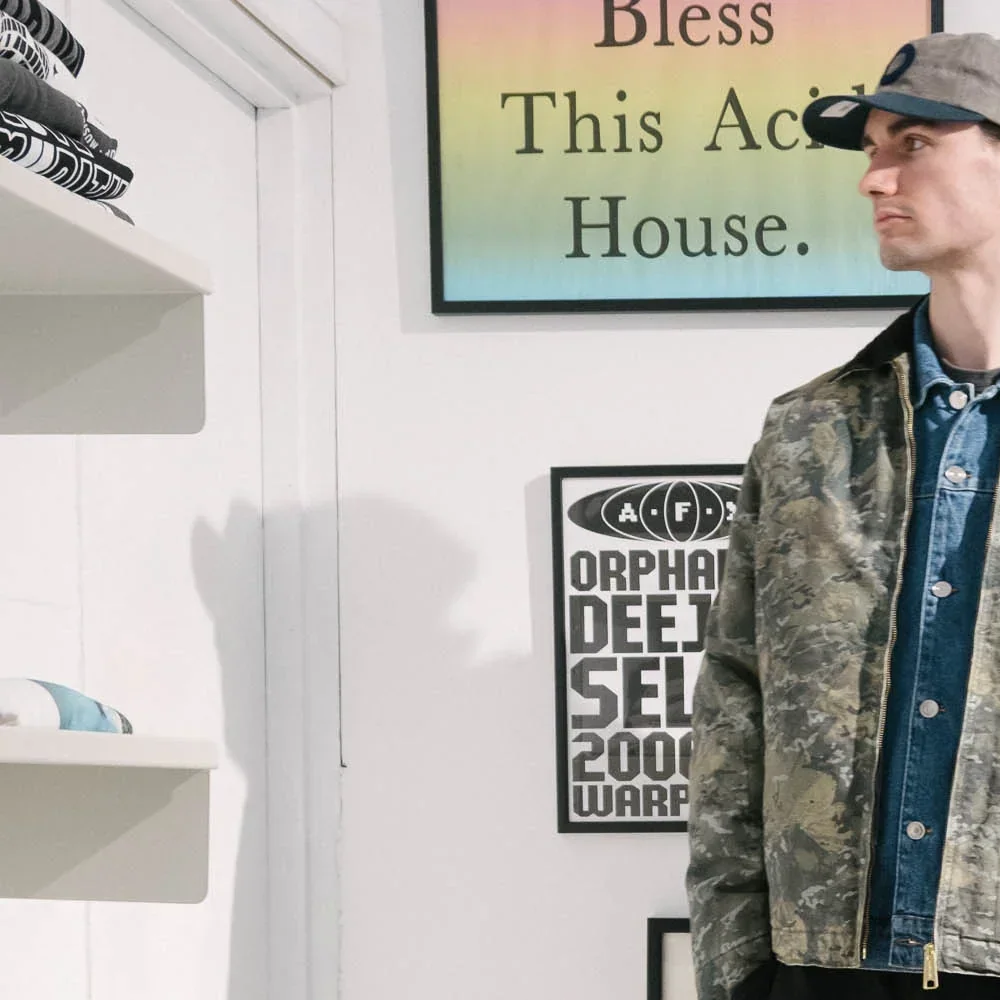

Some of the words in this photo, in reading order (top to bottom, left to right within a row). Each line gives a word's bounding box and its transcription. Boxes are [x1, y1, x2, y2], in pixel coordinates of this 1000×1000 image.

[594, 0, 774, 47] Bless
[501, 90, 664, 154] This
[703, 85, 866, 151] Ac
[564, 195, 809, 259] House.
[572, 784, 689, 817] WARP
